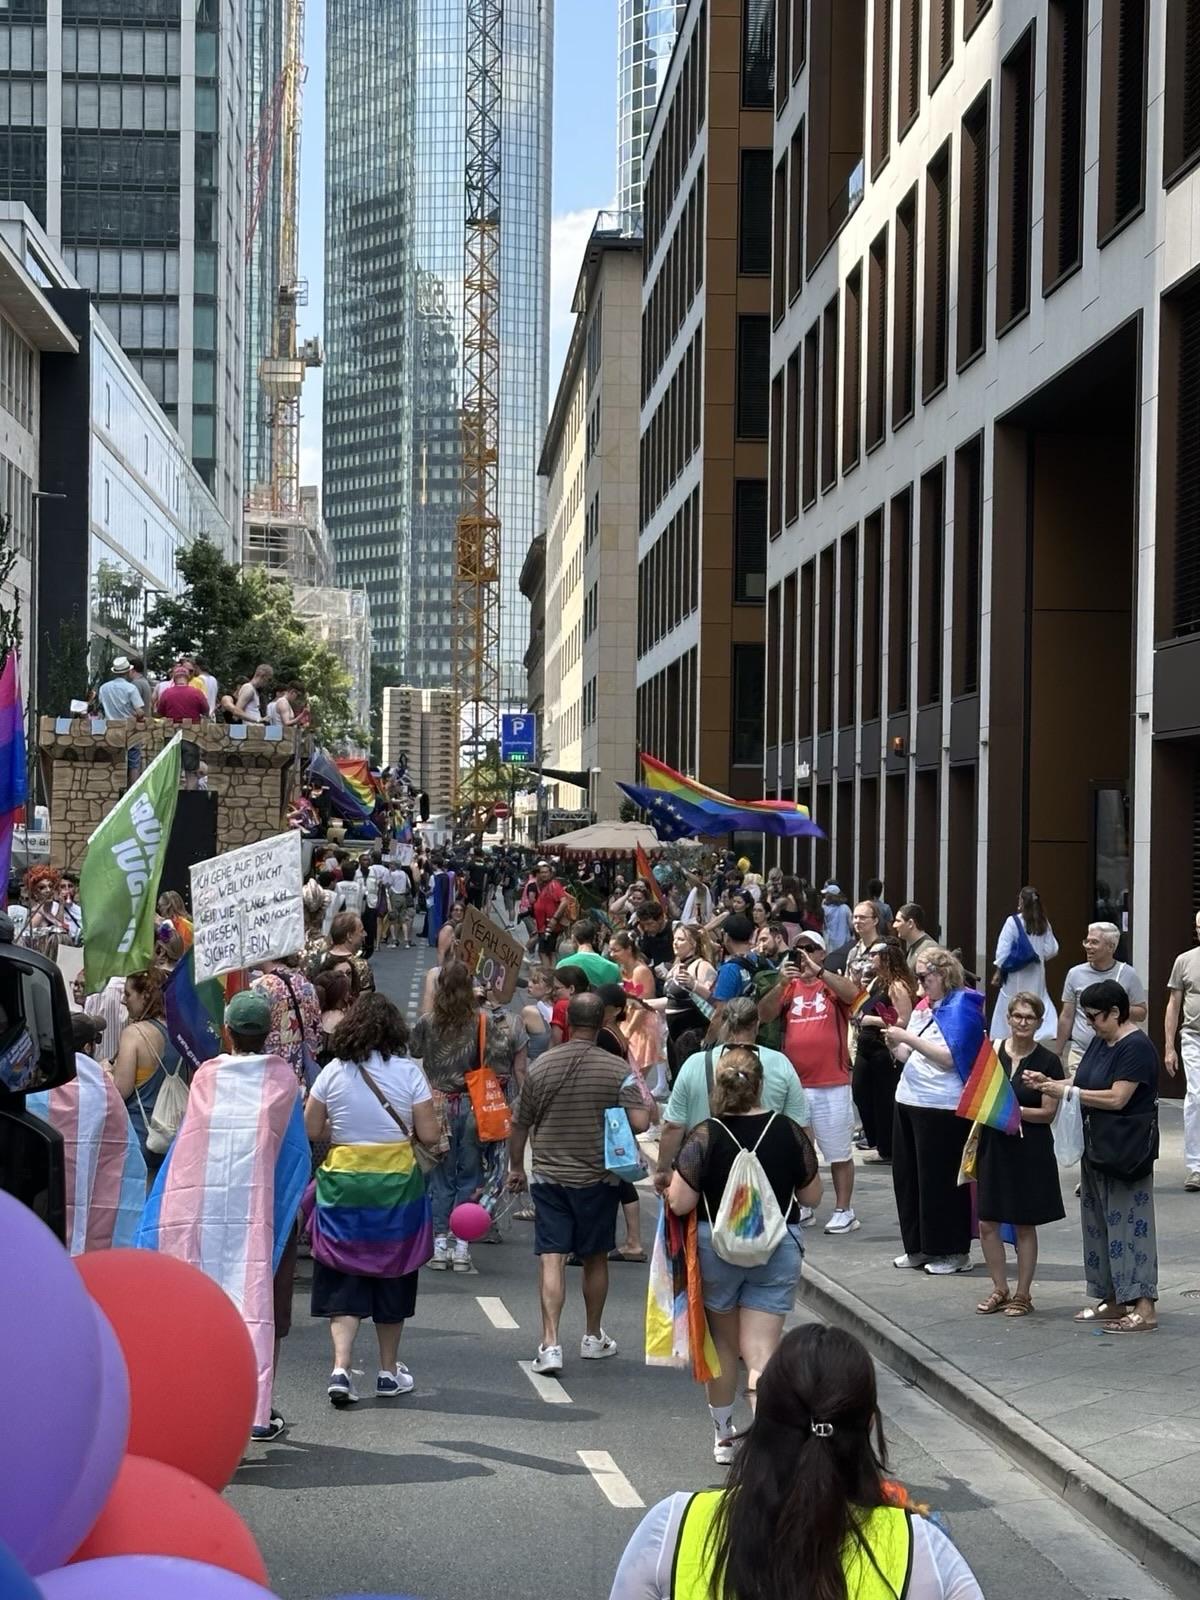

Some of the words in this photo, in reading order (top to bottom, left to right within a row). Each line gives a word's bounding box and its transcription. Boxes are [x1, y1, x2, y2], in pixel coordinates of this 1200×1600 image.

[513, 721, 525, 736] P
[211, 865, 231, 884] GEHE
[233, 858, 251, 875] AUF
[255, 850, 272, 868] DEN
[255, 864, 283, 883] NICHT
[207, 923, 240, 945] DIESEM
[470, 912, 499, 953] YEAH
[203, 943, 236, 967] SICHER
[251, 933, 270, 954] BIN
